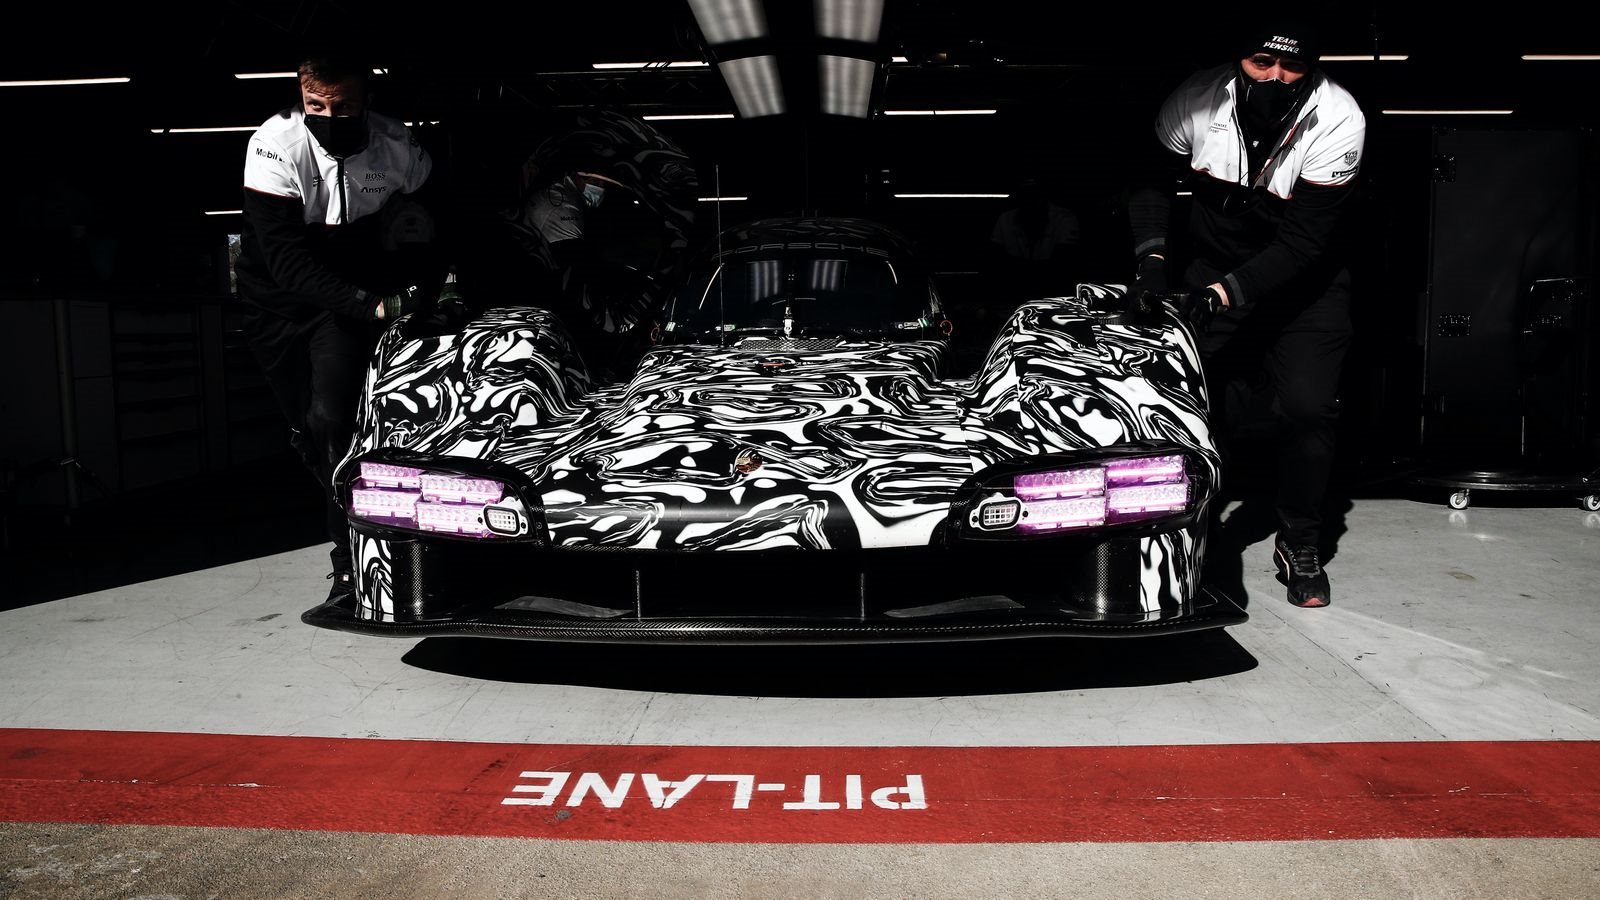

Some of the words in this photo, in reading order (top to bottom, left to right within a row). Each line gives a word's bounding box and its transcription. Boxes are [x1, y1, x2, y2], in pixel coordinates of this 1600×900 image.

[1272, 35, 1298, 45] TEAM
[1263, 41, 1300, 53] PENSKE
[255, 147, 278, 161] Mobil
[365, 172, 386, 180] BOSS
[360, 186, 386, 194] Ansys
[711, 242, 889, 260] PORSCHE
[501, 771, 928, 810] PIT-LANE
